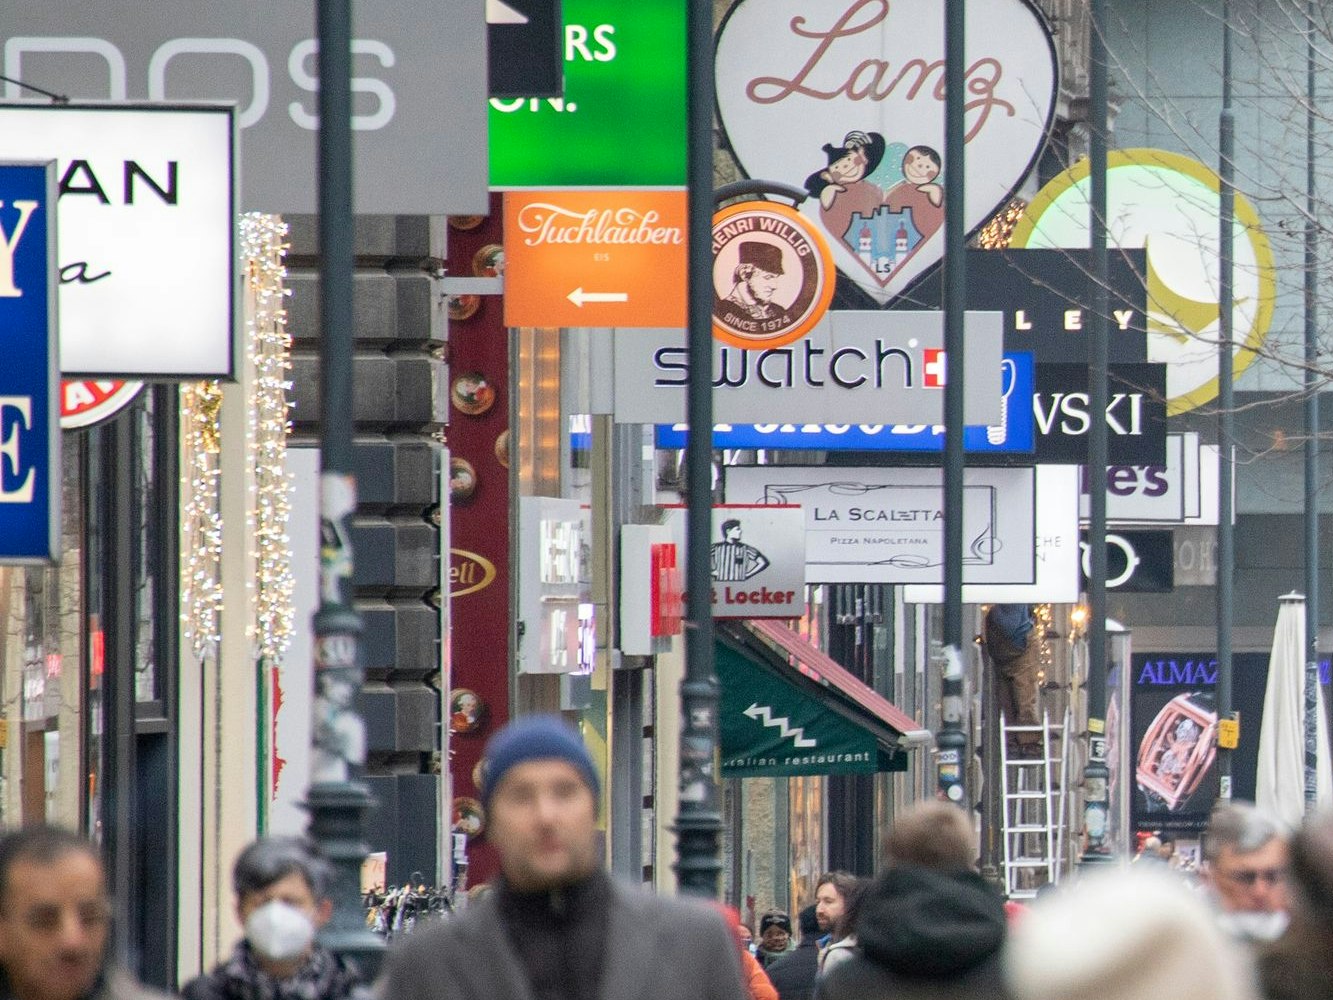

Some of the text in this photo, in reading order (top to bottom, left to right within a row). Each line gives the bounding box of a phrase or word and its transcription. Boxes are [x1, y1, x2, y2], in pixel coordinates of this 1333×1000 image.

[518, 203, 683, 246] Tuchlauben
[759, 217, 811, 257] WILLIG
[723, 312, 792, 332] SINCE 1974
[653, 338, 914, 390] swatch
[725, 586, 796, 605] Locker
[784, 751, 870, 766] restaurant
